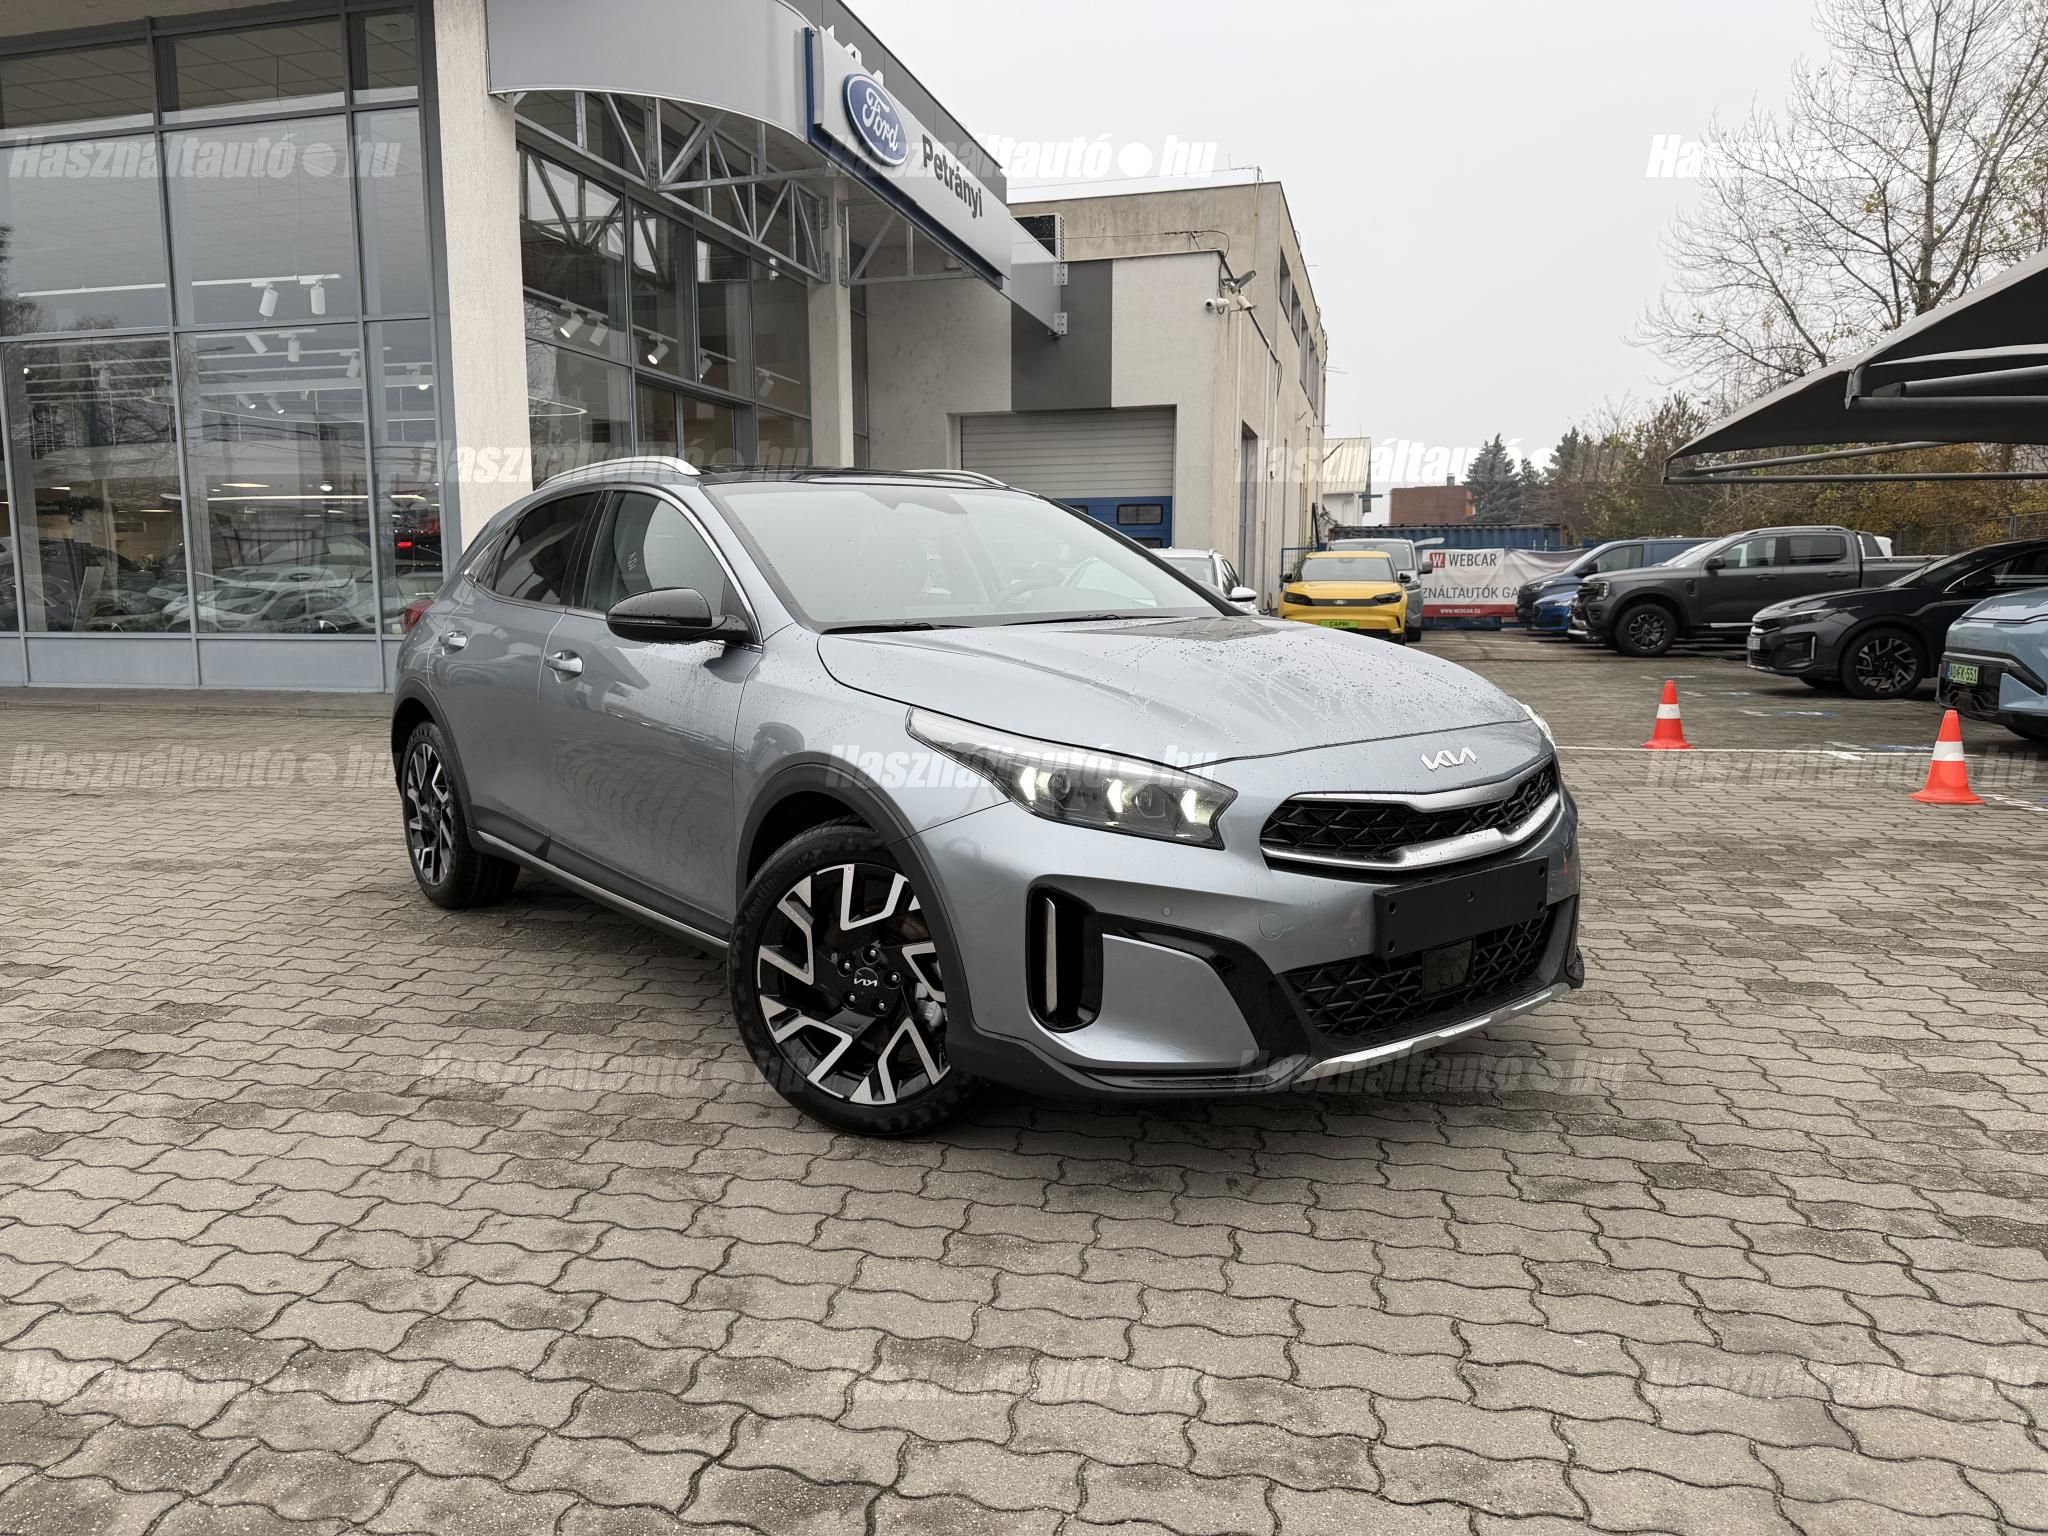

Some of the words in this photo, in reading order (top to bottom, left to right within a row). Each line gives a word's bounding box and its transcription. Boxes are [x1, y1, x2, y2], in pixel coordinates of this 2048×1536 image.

[862, 87, 899, 151] Ford
[922, 134, 983, 218] Petrányi
[1449, 553, 1497, 567] WEBCAR
